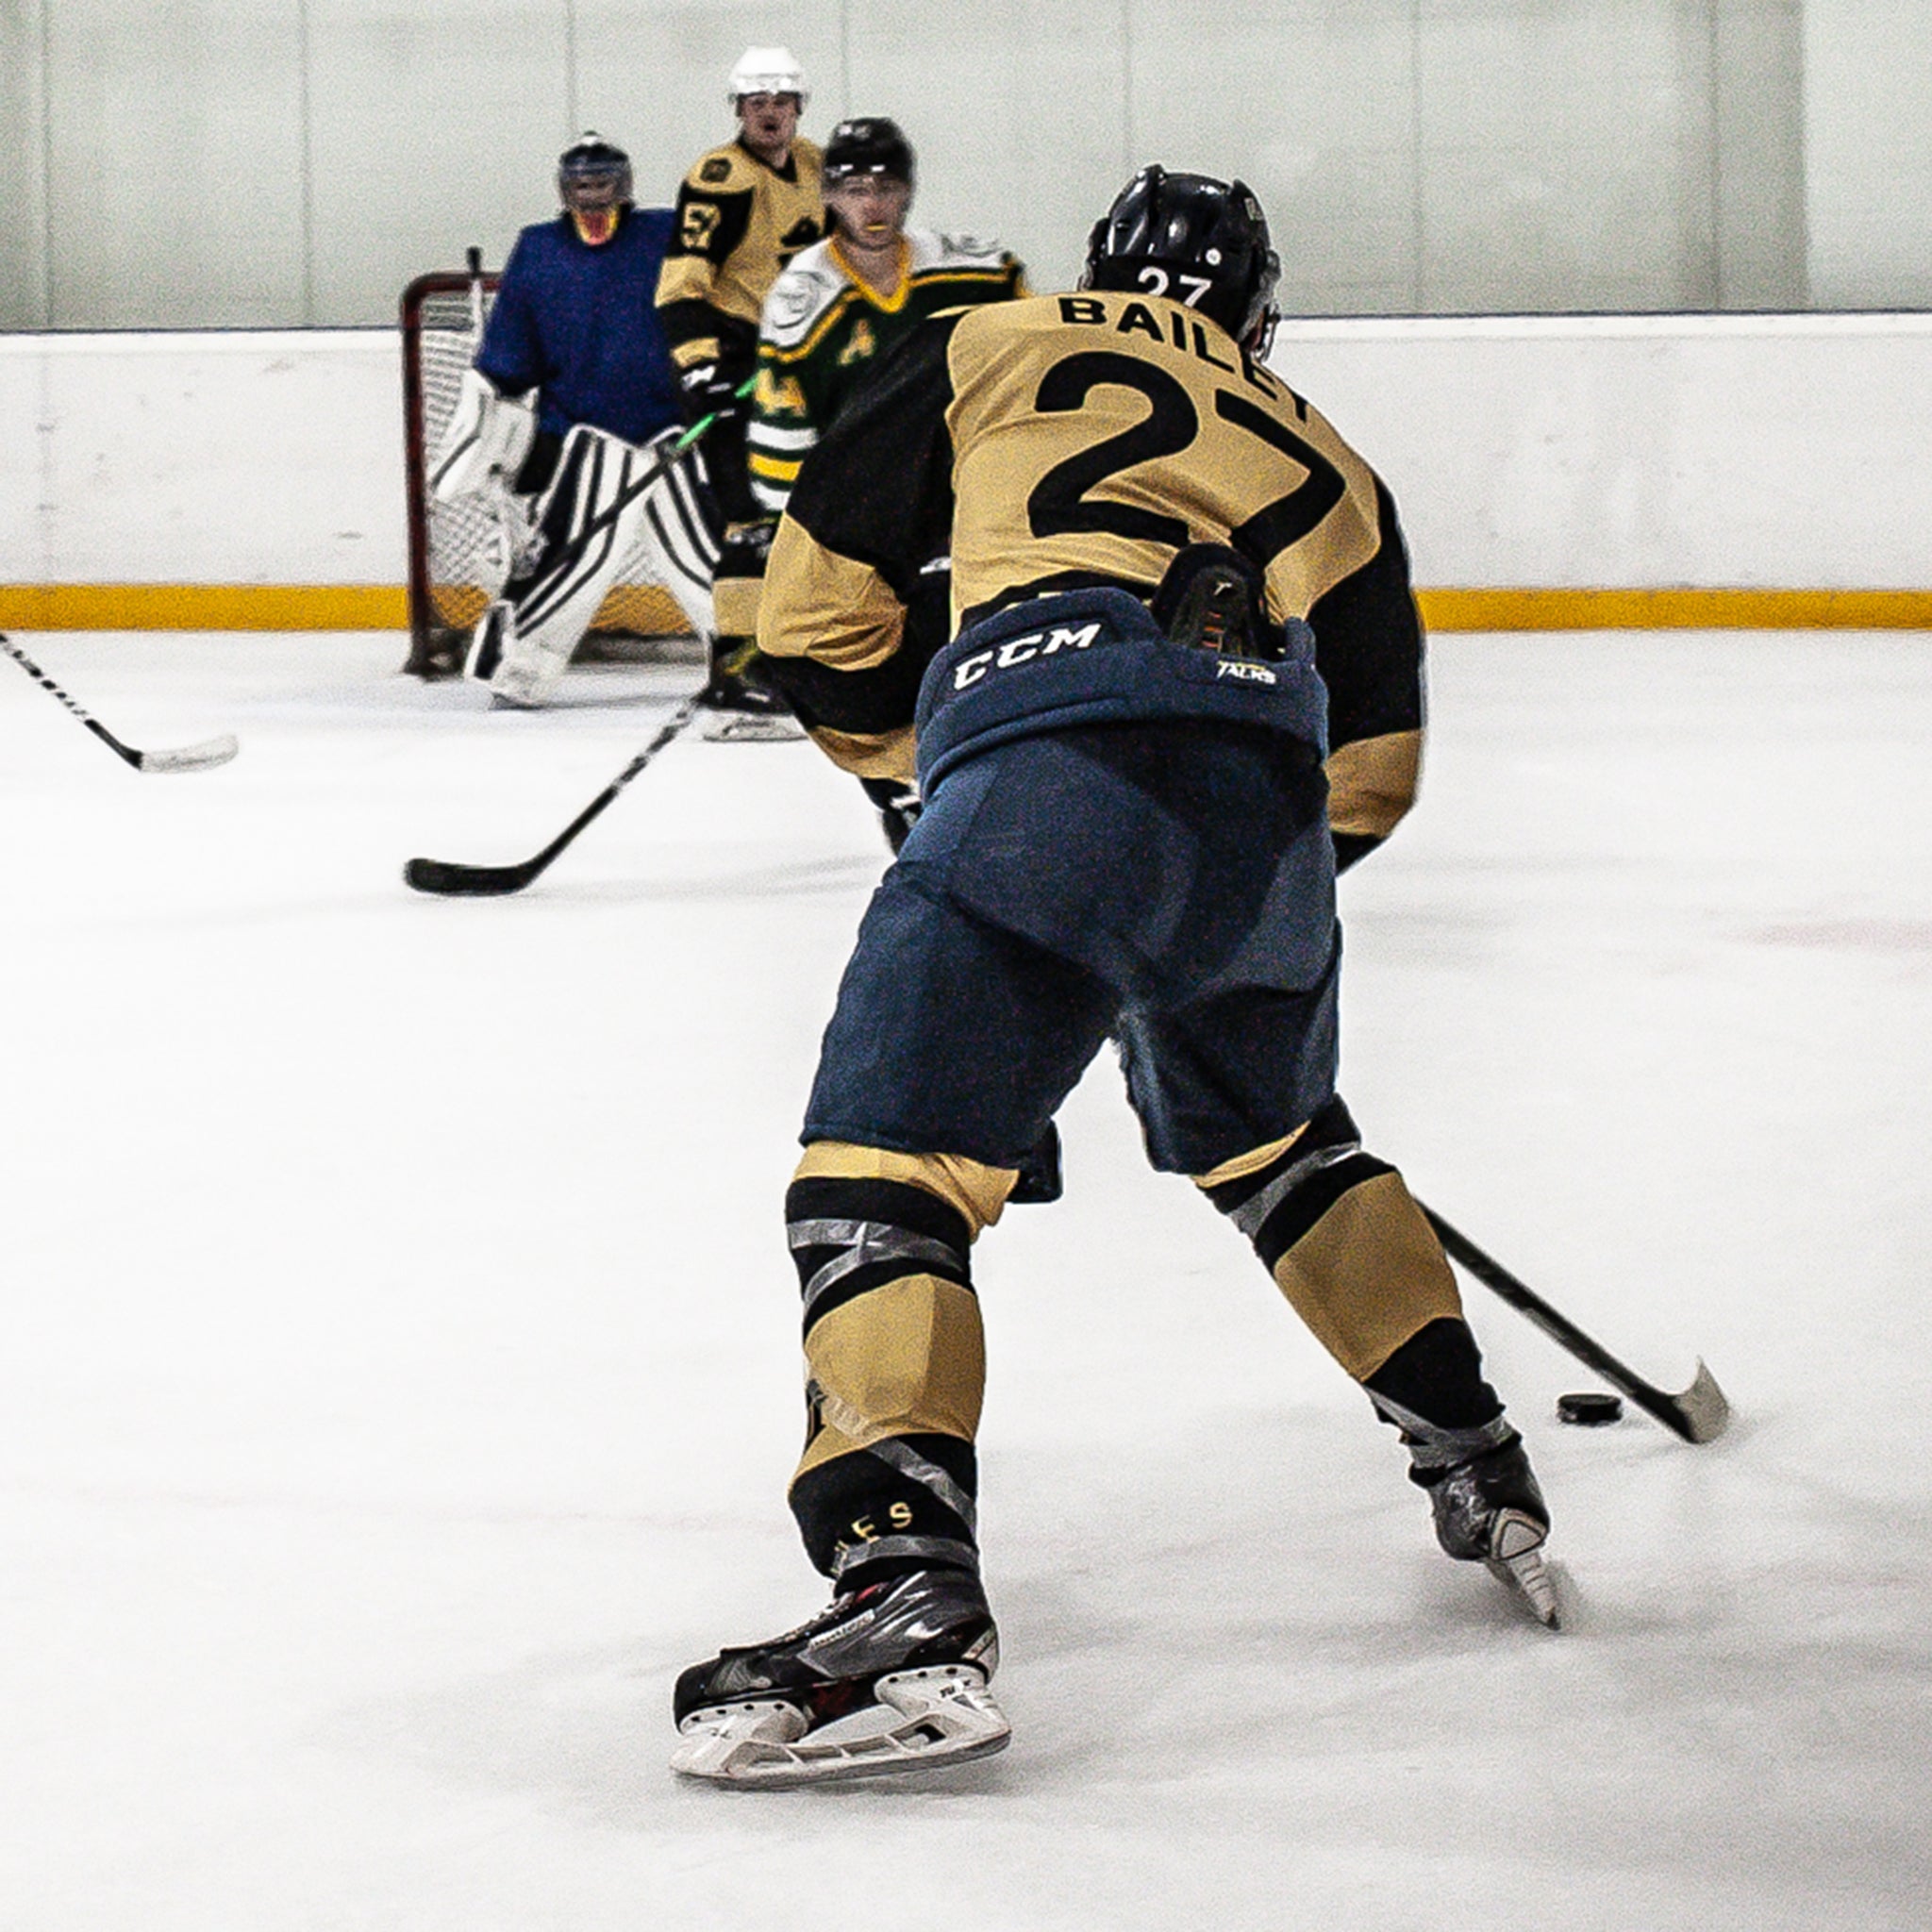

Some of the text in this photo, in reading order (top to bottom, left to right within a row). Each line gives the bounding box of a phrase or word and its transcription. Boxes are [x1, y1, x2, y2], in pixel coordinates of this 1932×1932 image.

[682, 201, 722, 249] 57
[1138, 265, 1211, 307] 27
[1027, 350, 1346, 568] 27
[954, 623, 1101, 690] CCM
